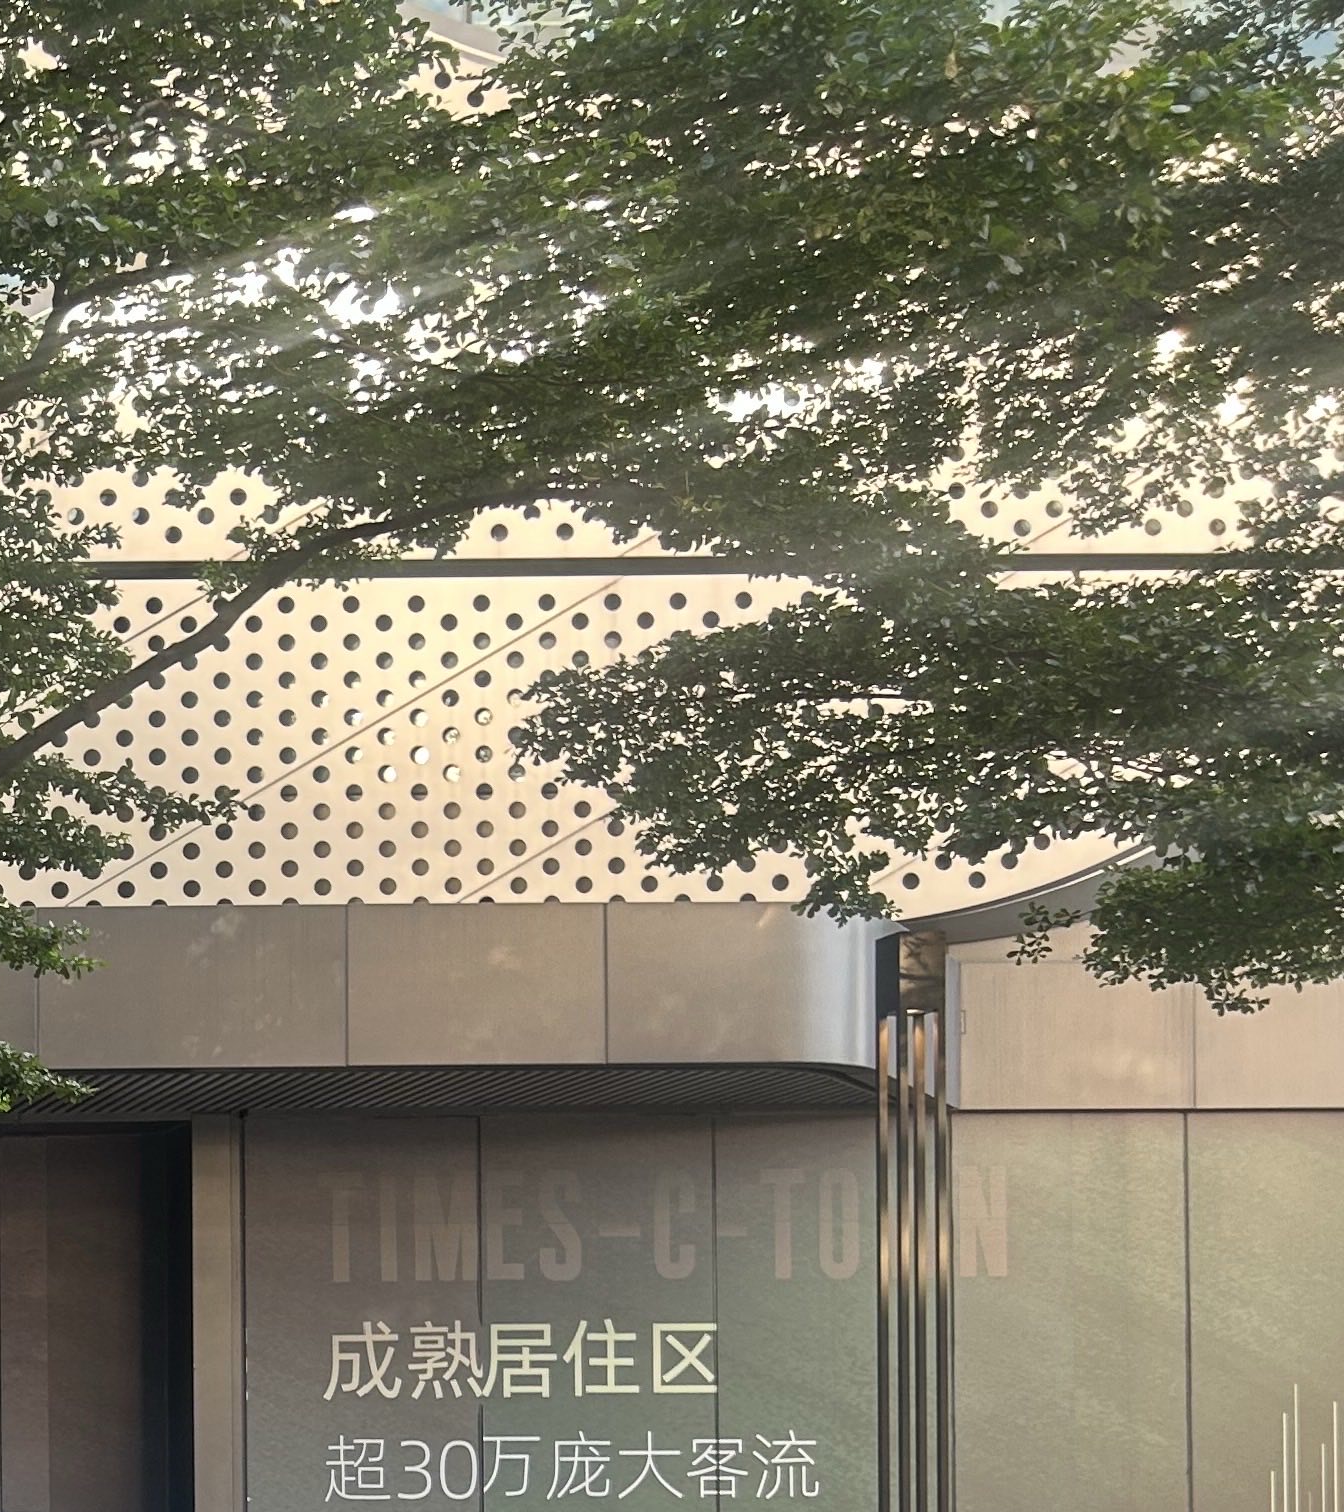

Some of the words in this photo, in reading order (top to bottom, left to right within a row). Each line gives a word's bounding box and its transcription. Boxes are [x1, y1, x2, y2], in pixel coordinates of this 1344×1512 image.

[322, 1166, 1008, 1283] TIMES-C-TON
[323, 1319, 718, 1400] 成熟居住区
[324, 1430, 820, 1501] 超30万庞大客流
